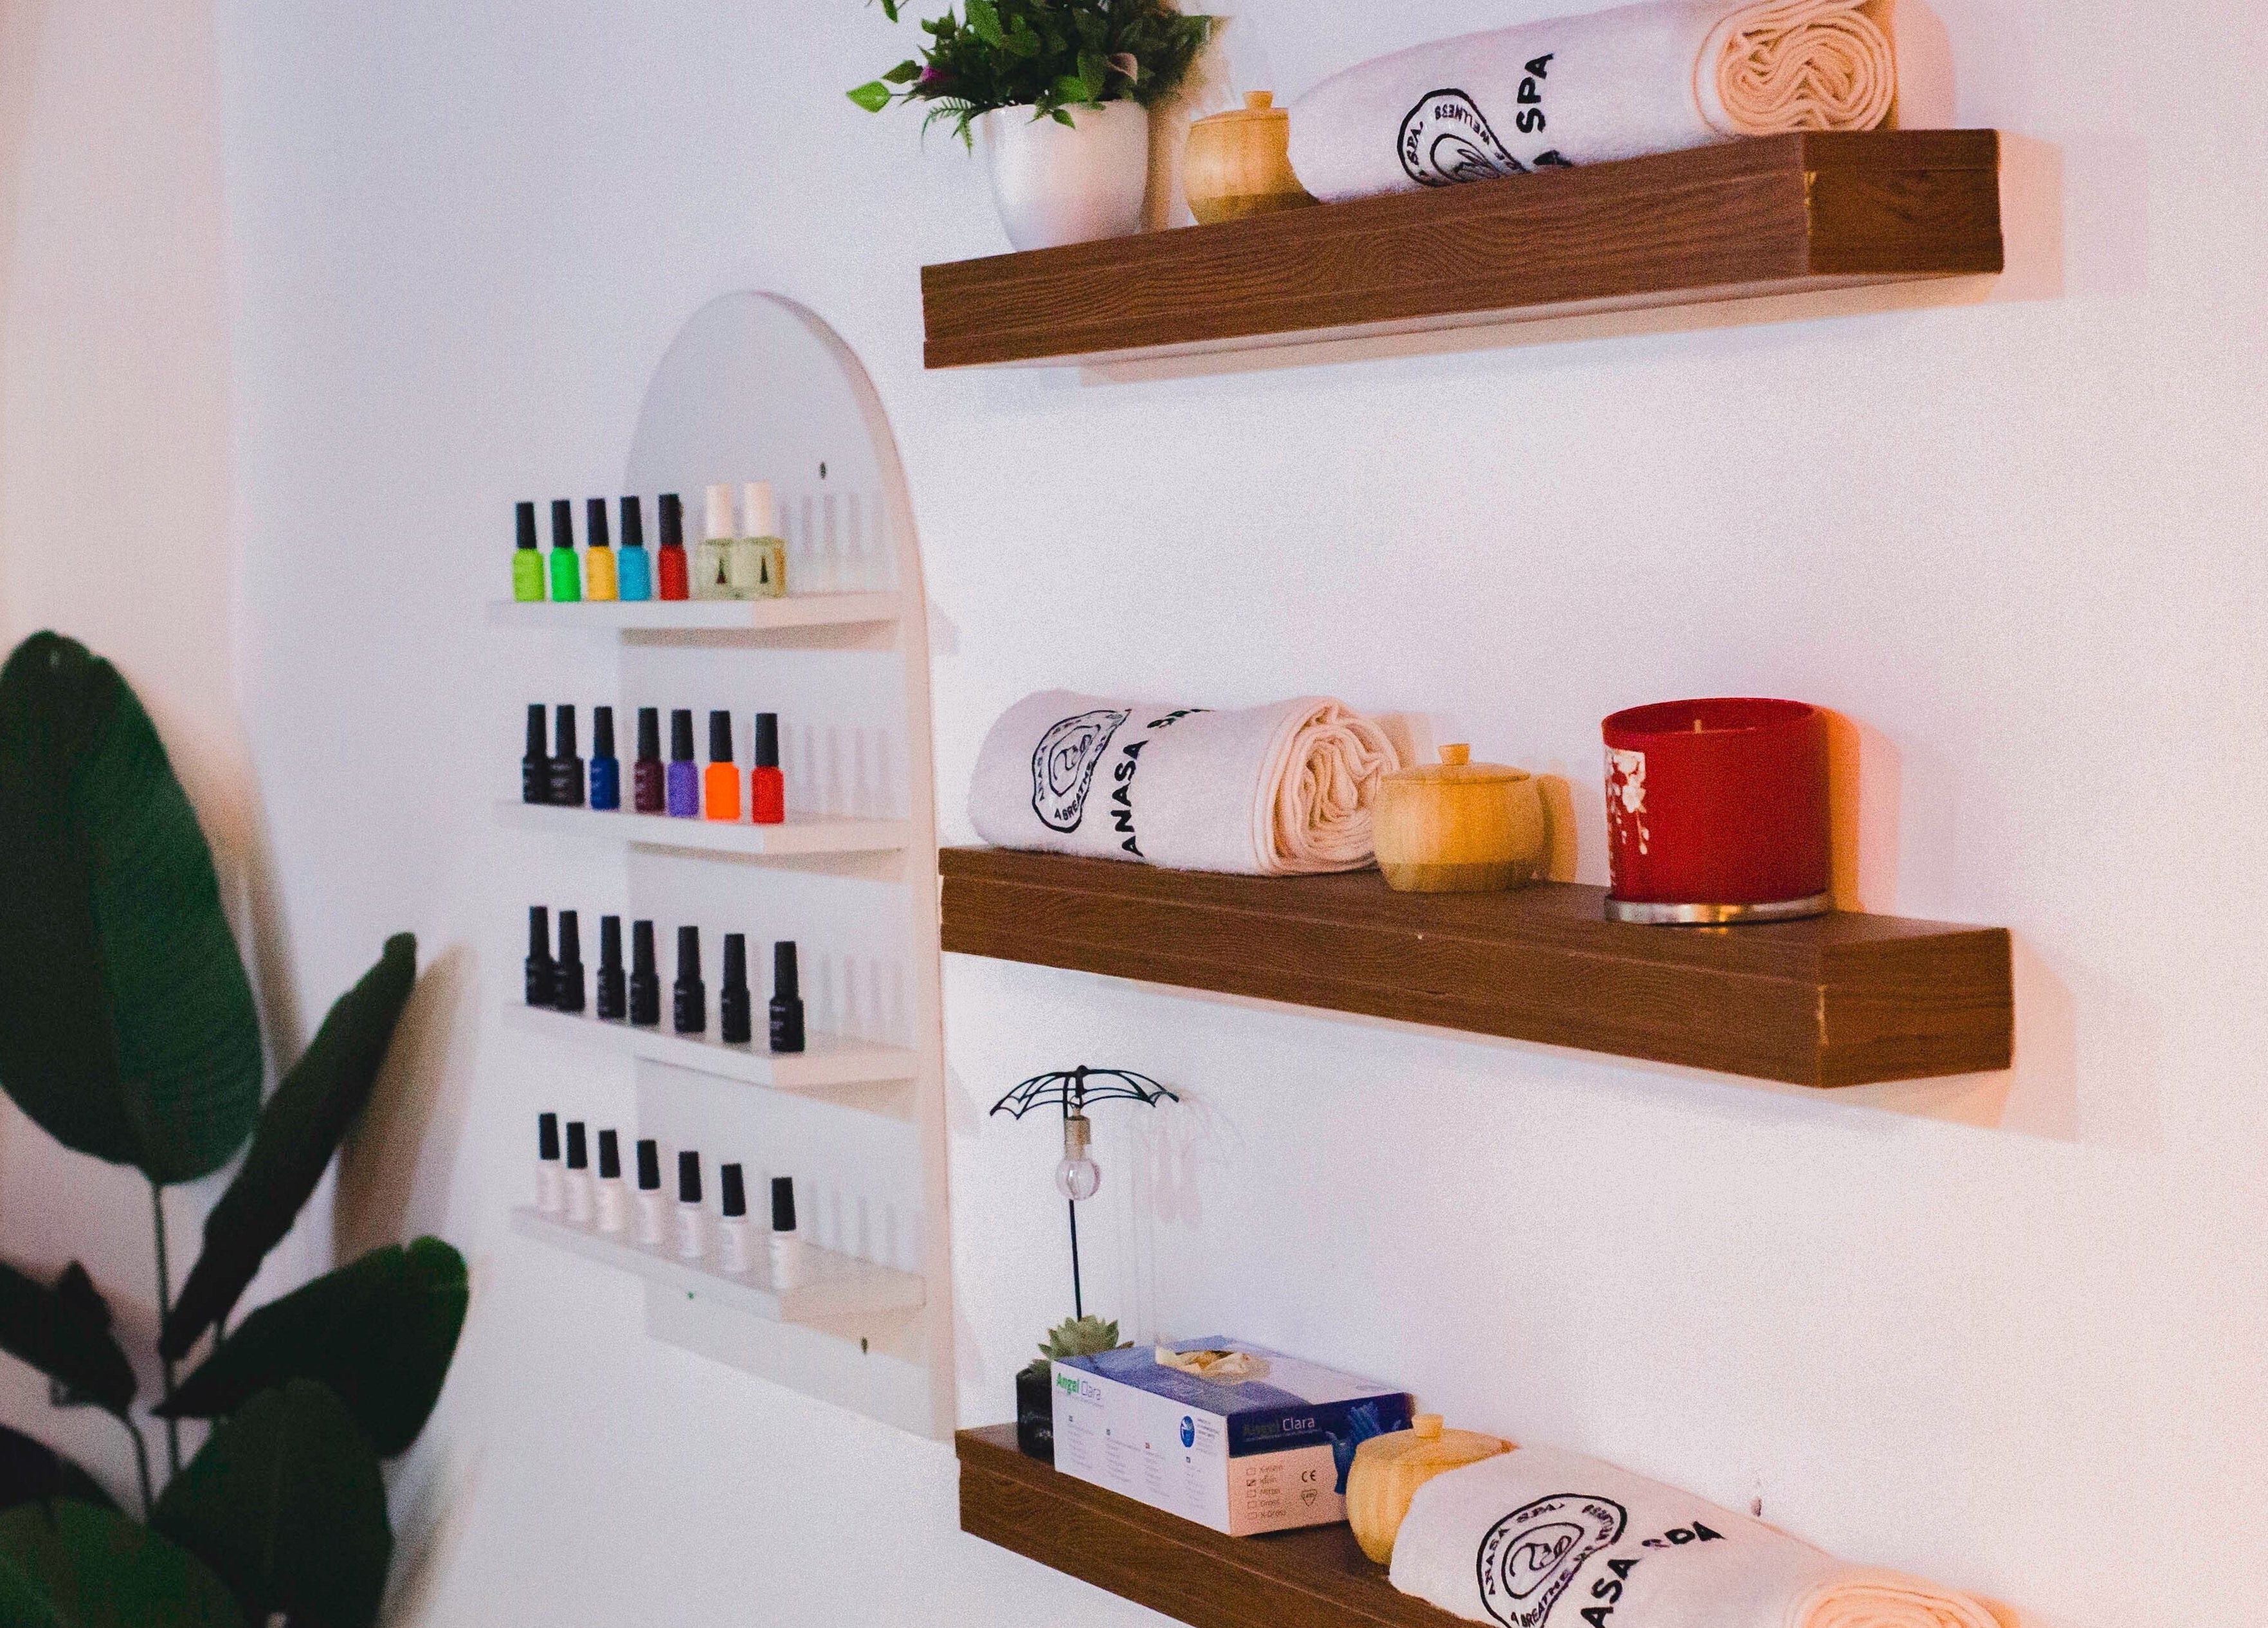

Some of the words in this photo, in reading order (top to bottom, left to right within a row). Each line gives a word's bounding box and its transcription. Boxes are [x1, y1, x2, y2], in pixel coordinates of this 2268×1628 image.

[1516, 53, 1555, 134] SPA
[1111, 740, 1150, 859] ANASA
[1057, 1372, 1080, 1396] Angel
[1081, 1380, 1102, 1401] Clara
[1282, 1416, 1316, 1432] Clara
